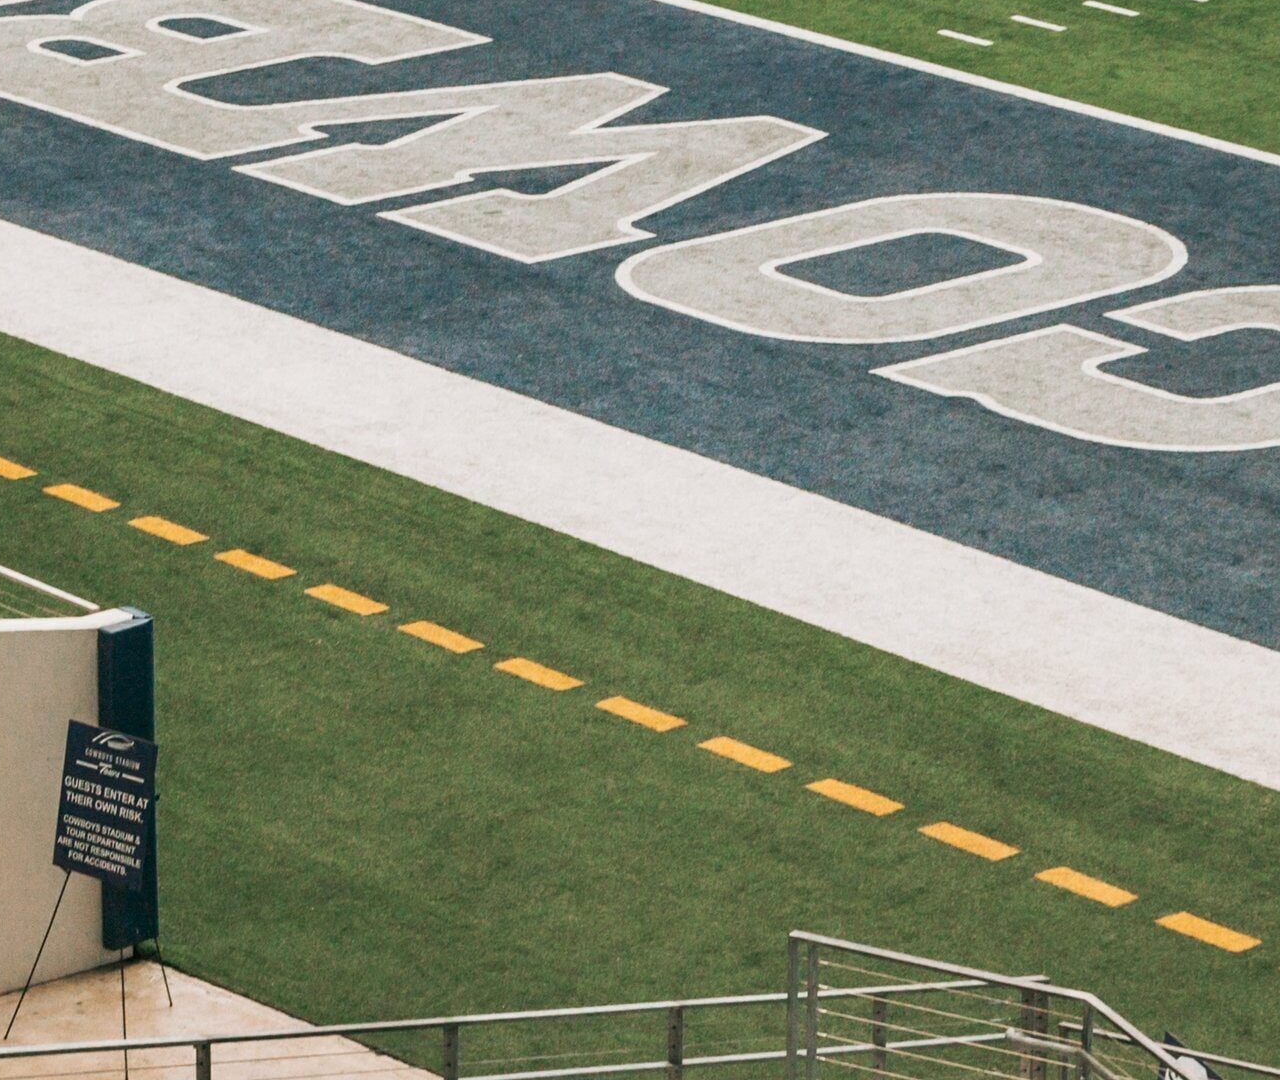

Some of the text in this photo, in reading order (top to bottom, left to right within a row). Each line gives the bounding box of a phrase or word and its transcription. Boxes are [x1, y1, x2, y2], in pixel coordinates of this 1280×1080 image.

[84, 747, 140, 771] COWBOYS STADIUM
[64, 775, 149, 809] GUESTS ENTER AT
[66, 790, 144, 824] THEIR OWN RISK.
[63, 814, 141, 845] COWBOYS STADIUM &
[66, 826, 136, 855] TOUR DEPARTMENT
[57, 835, 141, 868] ARE NOT RESPONSIBLE
[68, 850, 127, 876] FOR ACCIDENTS.
